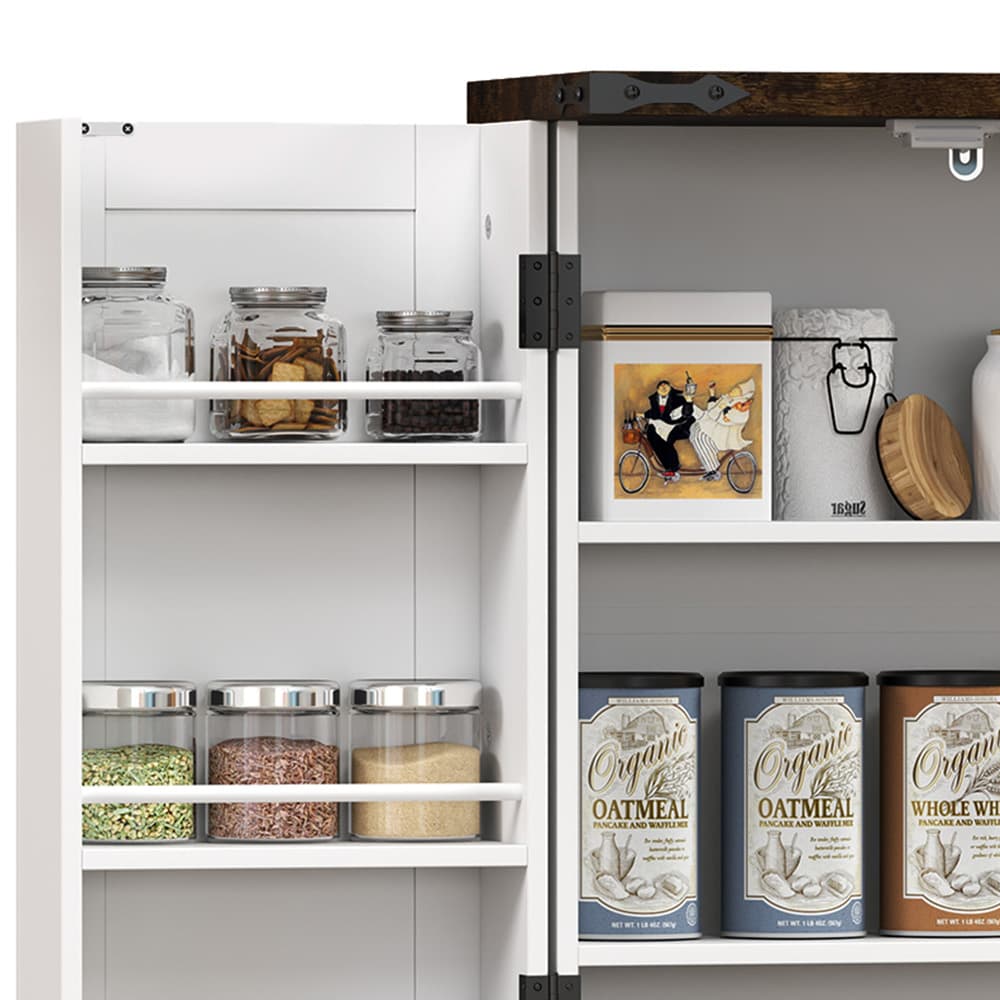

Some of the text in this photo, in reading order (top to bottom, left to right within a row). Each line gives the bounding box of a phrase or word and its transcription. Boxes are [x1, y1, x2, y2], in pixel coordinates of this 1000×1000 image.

[588, 722, 688, 797] Organic
[754, 721, 852, 796] Organic
[592, 799, 689, 820] OATMEAL
[758, 797, 854, 819] OATMEAL
[911, 800, 970, 817] WHOLE
[593, 821, 629, 829] PANCAKE
[630, 821, 647, 829] AND
[759, 820, 794, 828] PANCAKE
[795, 820, 814, 828] AND
[918, 818, 954, 827] PANCAKE
[955, 818, 973, 827] AND
